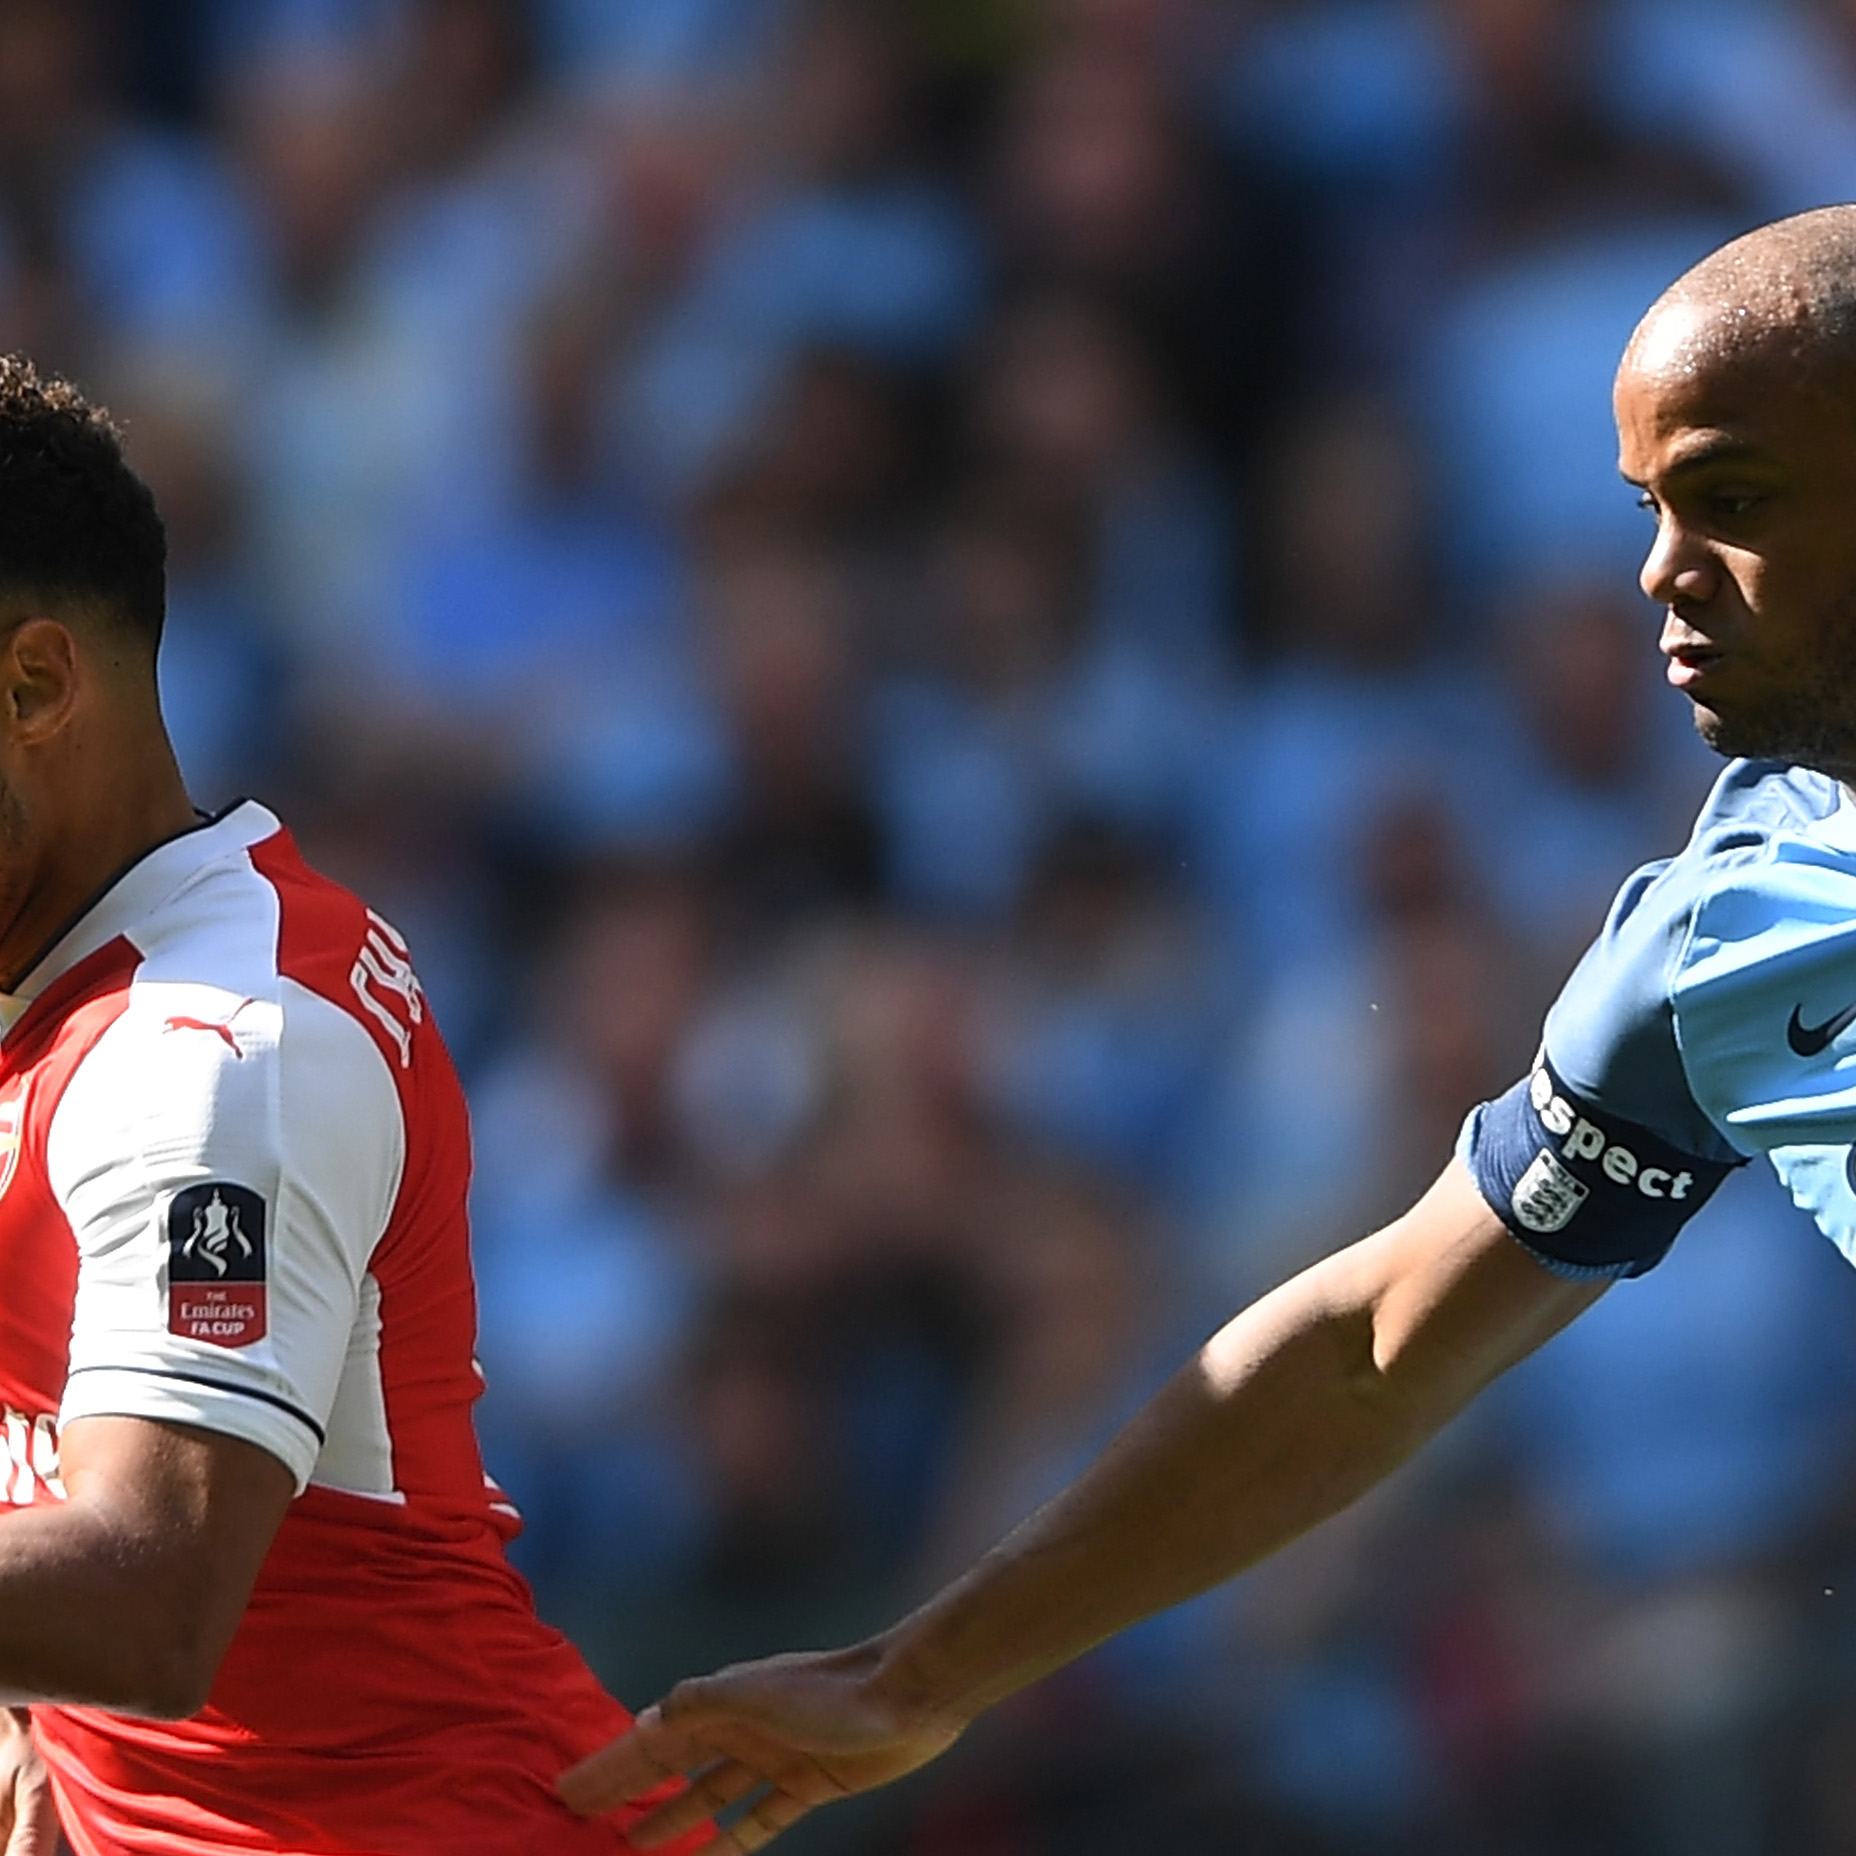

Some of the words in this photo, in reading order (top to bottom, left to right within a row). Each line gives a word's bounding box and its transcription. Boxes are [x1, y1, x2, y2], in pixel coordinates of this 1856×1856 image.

[180, 1301, 255, 1319] Emirates
[191, 1320, 211, 1336] FA
[212, 1320, 245, 1335] CUP
